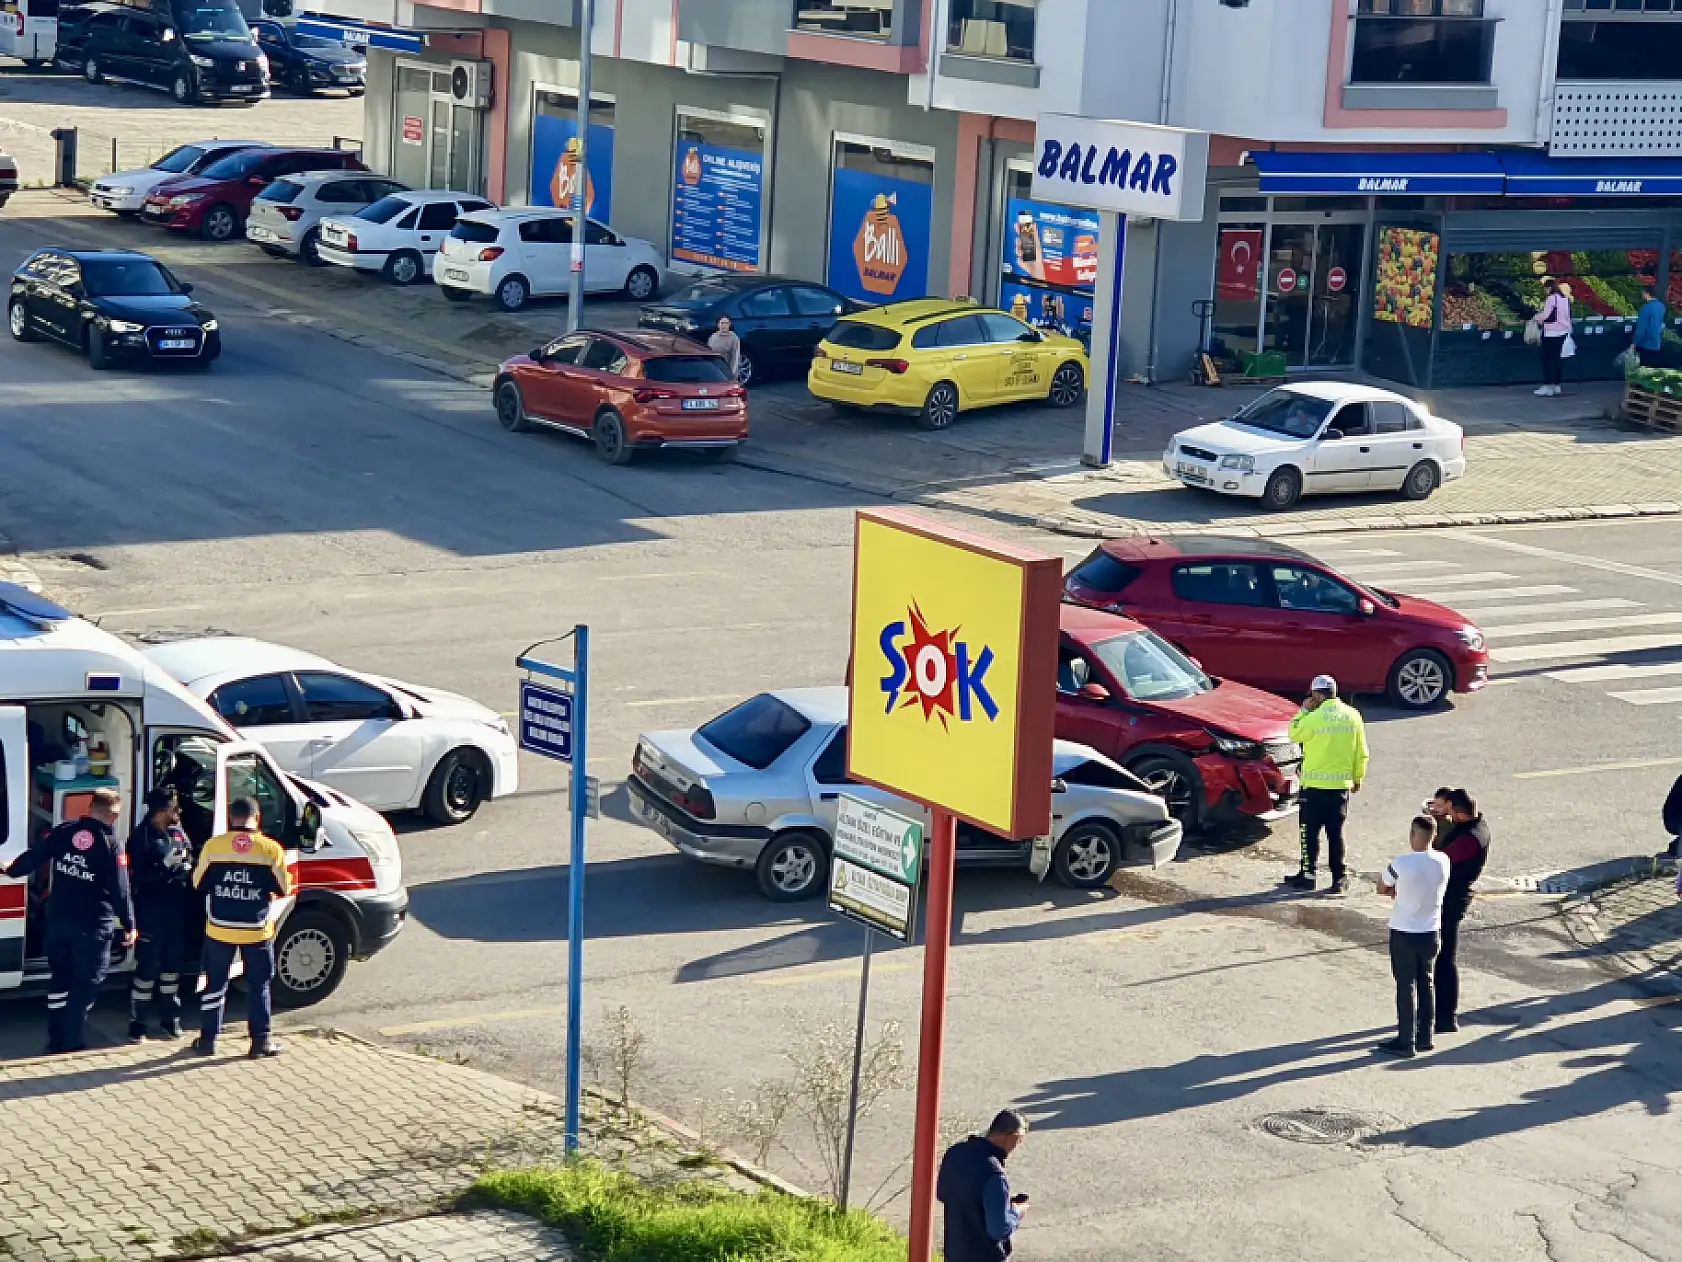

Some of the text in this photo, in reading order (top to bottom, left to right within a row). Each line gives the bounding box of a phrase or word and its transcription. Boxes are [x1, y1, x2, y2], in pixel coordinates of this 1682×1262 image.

[1038, 139, 1178, 196] BALMAR
[1358, 178, 1408, 191] BALMAR
[1595, 180, 1642, 193] BALMAR
[879, 621, 1000, 722] ŞOK
[222, 868, 253, 884] ACİL
[214, 884, 262, 900] SAĞLIK
